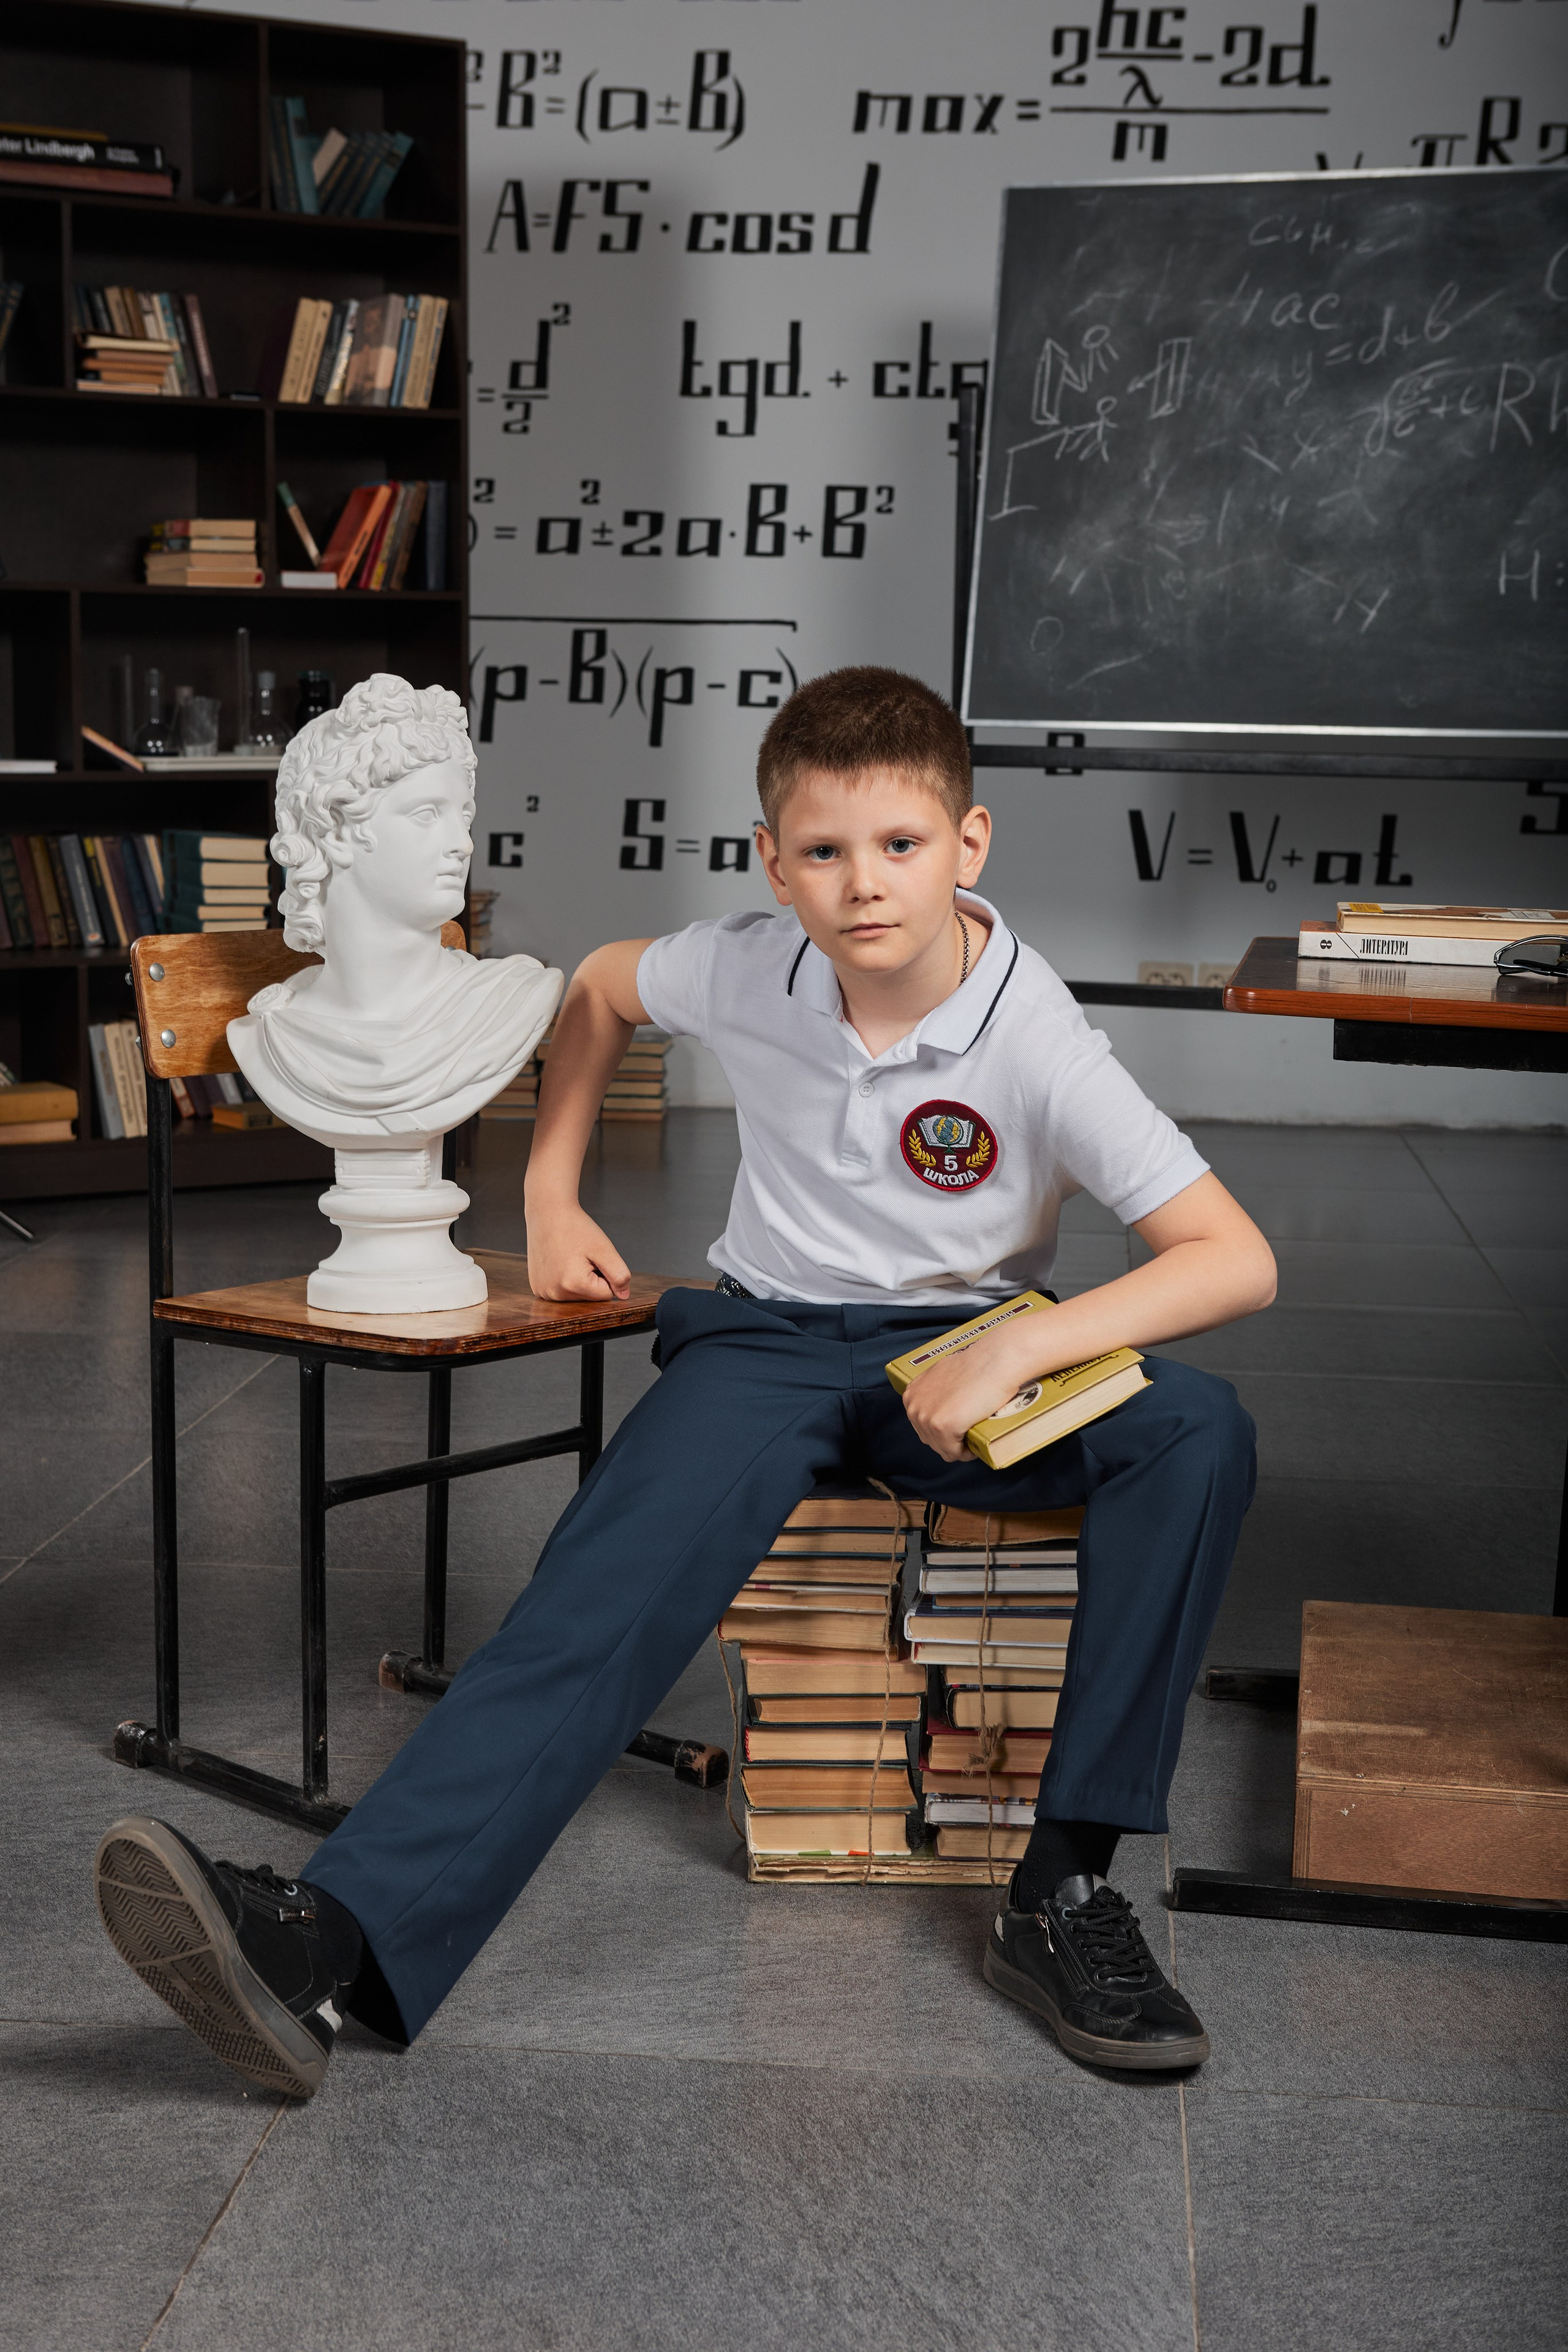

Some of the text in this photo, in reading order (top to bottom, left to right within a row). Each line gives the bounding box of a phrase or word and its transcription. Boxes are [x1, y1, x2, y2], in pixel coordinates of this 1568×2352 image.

[24, 137, 96, 163] Lindbergh
[1360, 938, 1409, 956] ЛИТЕРАТУРА
[944, 1155, 958, 1171] 5
[922, 1167, 980, 1186] ШКОЛА
[928, 1310, 1016, 1357] ИСТОРИЧЕСКИЕ РОМАНЫ
